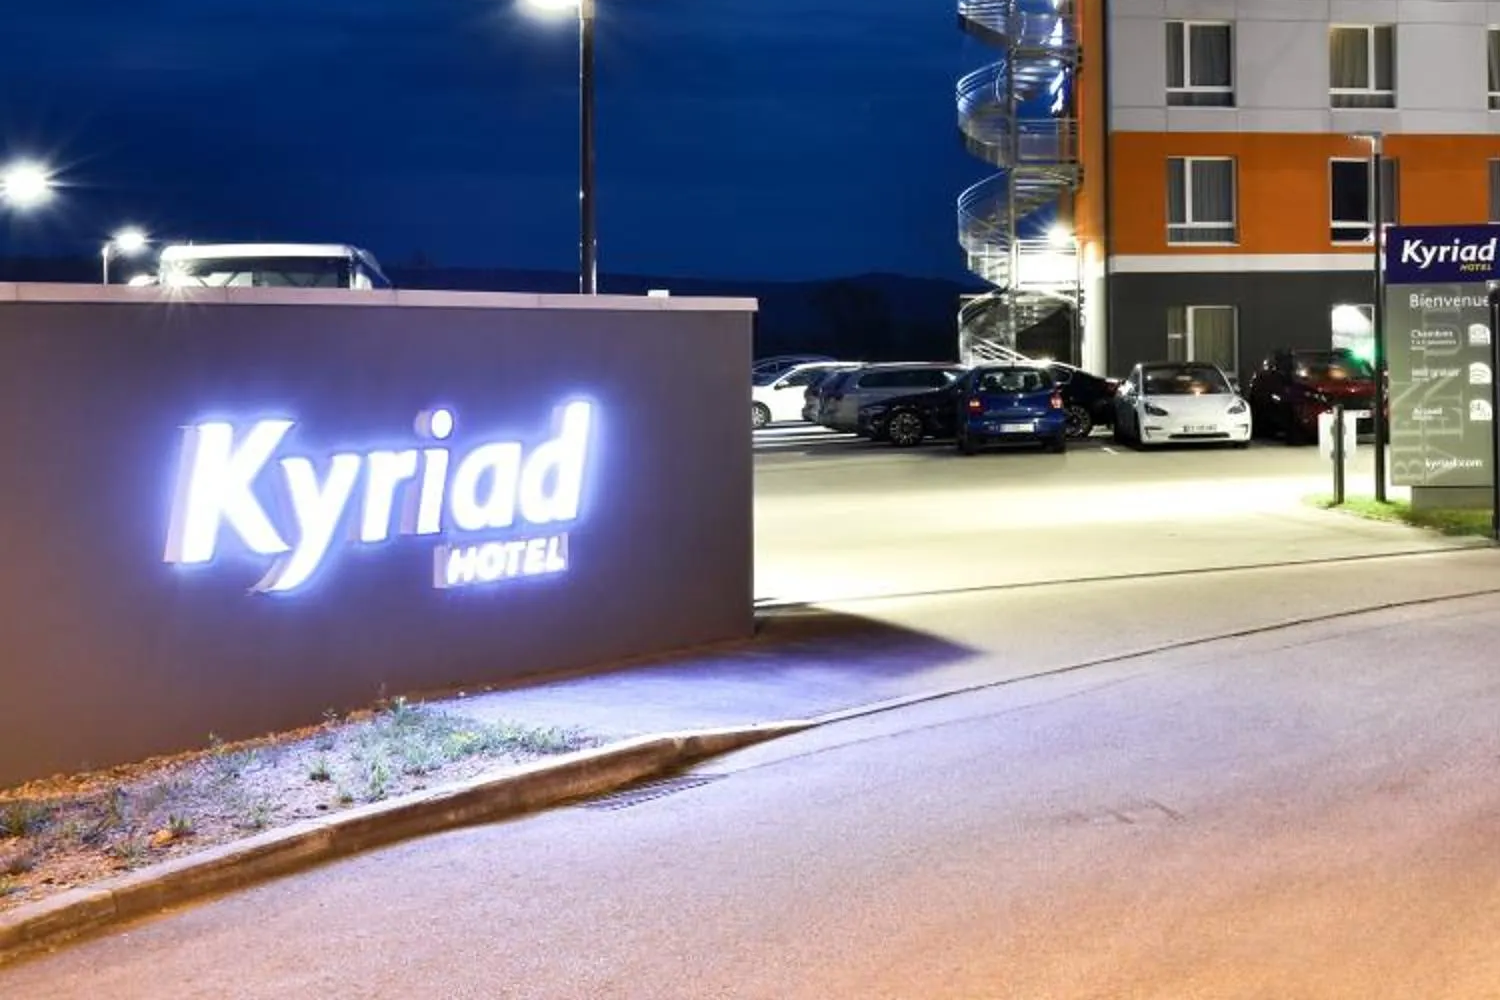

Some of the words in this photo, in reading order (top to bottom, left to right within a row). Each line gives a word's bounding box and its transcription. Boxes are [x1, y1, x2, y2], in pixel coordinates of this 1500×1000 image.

[1401, 237, 1498, 269] Kyriad
[1460, 263, 1492, 271] HOTEL
[164, 401, 592, 595] Kyriad
[438, 534, 568, 588] HOTEL
